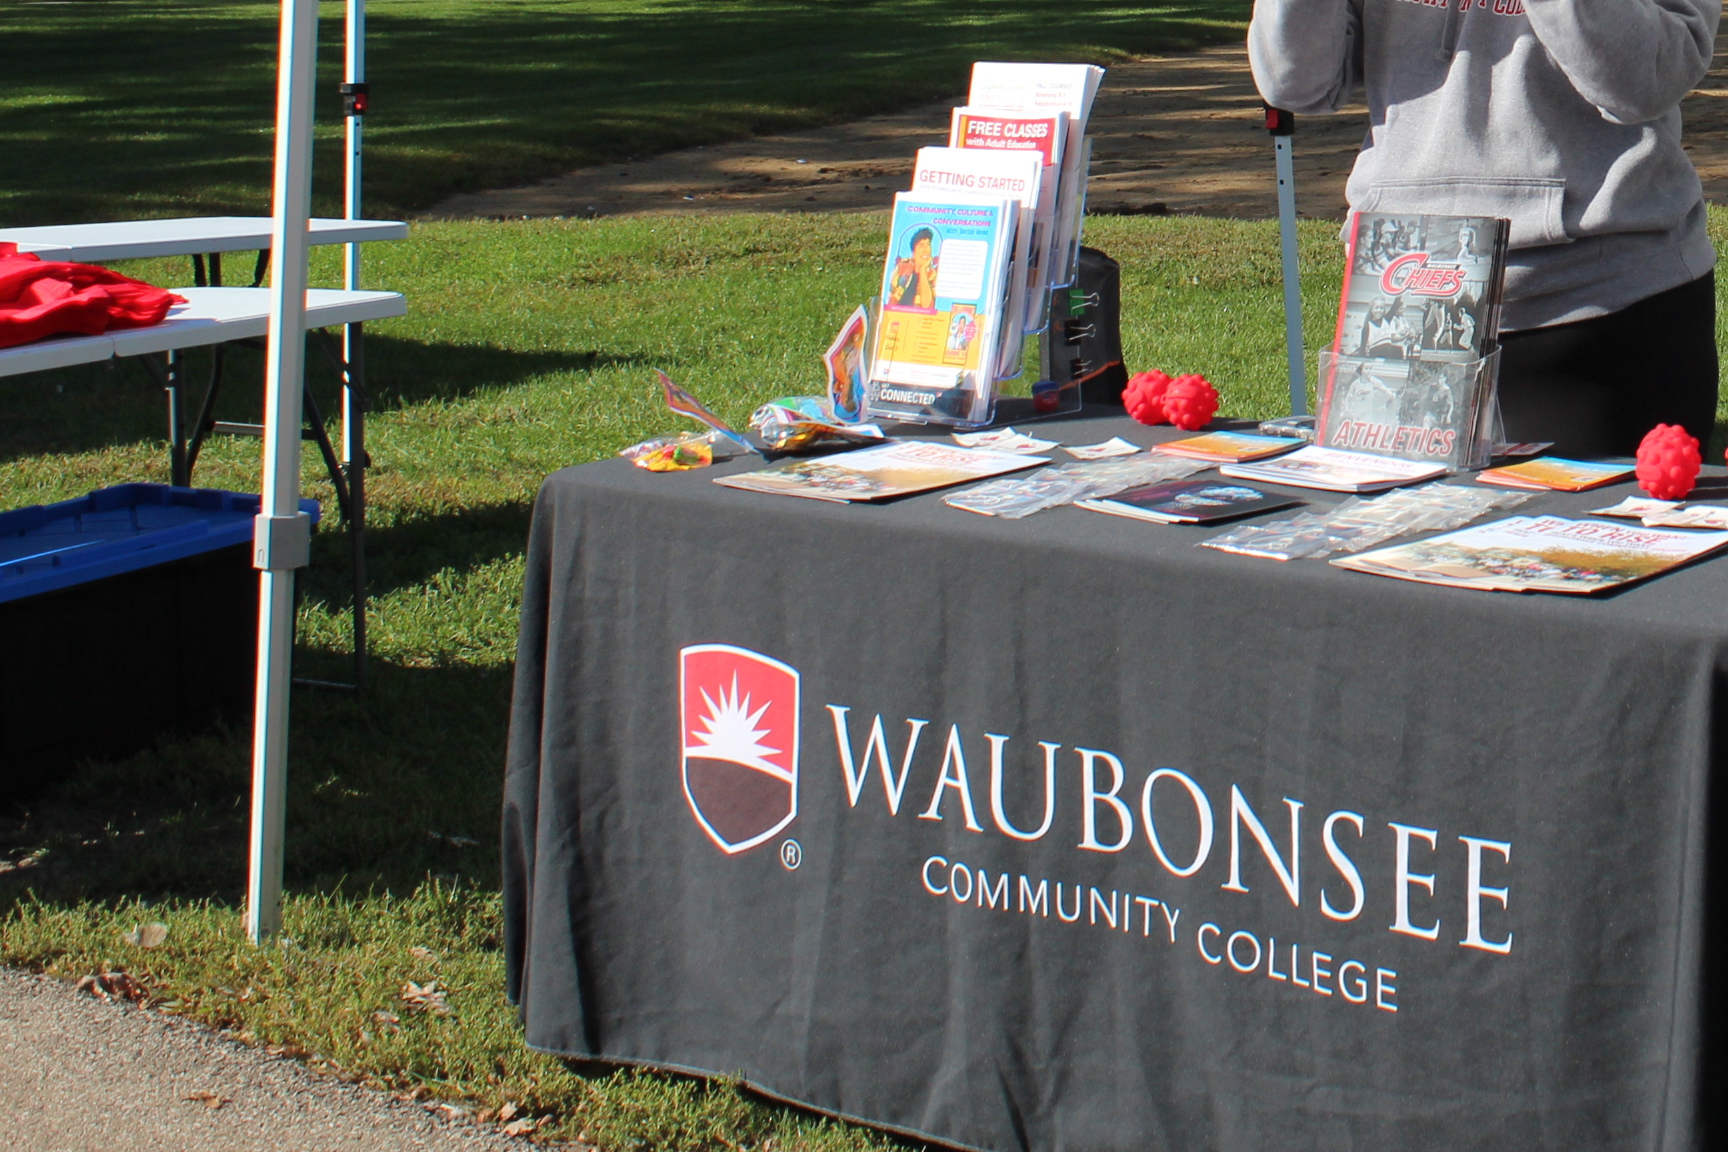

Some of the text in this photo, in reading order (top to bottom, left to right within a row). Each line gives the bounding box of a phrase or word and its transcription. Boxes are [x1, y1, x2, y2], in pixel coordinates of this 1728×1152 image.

[967, 121, 1048, 138] FREE CLASSES
[966, 138, 1036, 149] with Adult Education
[919, 169, 1025, 191] GETTING STARTED
[933, 218, 991, 226] CONVERSATIONS
[1379, 251, 1467, 297] CHIEFS
[880, 388, 936, 405] CONNECTED
[1331, 419, 1456, 457] ATHLETICS
[824, 703, 1514, 954] WAUBONSEE
[920, 854, 1399, 1012] COMMUNITY COLLEGE
